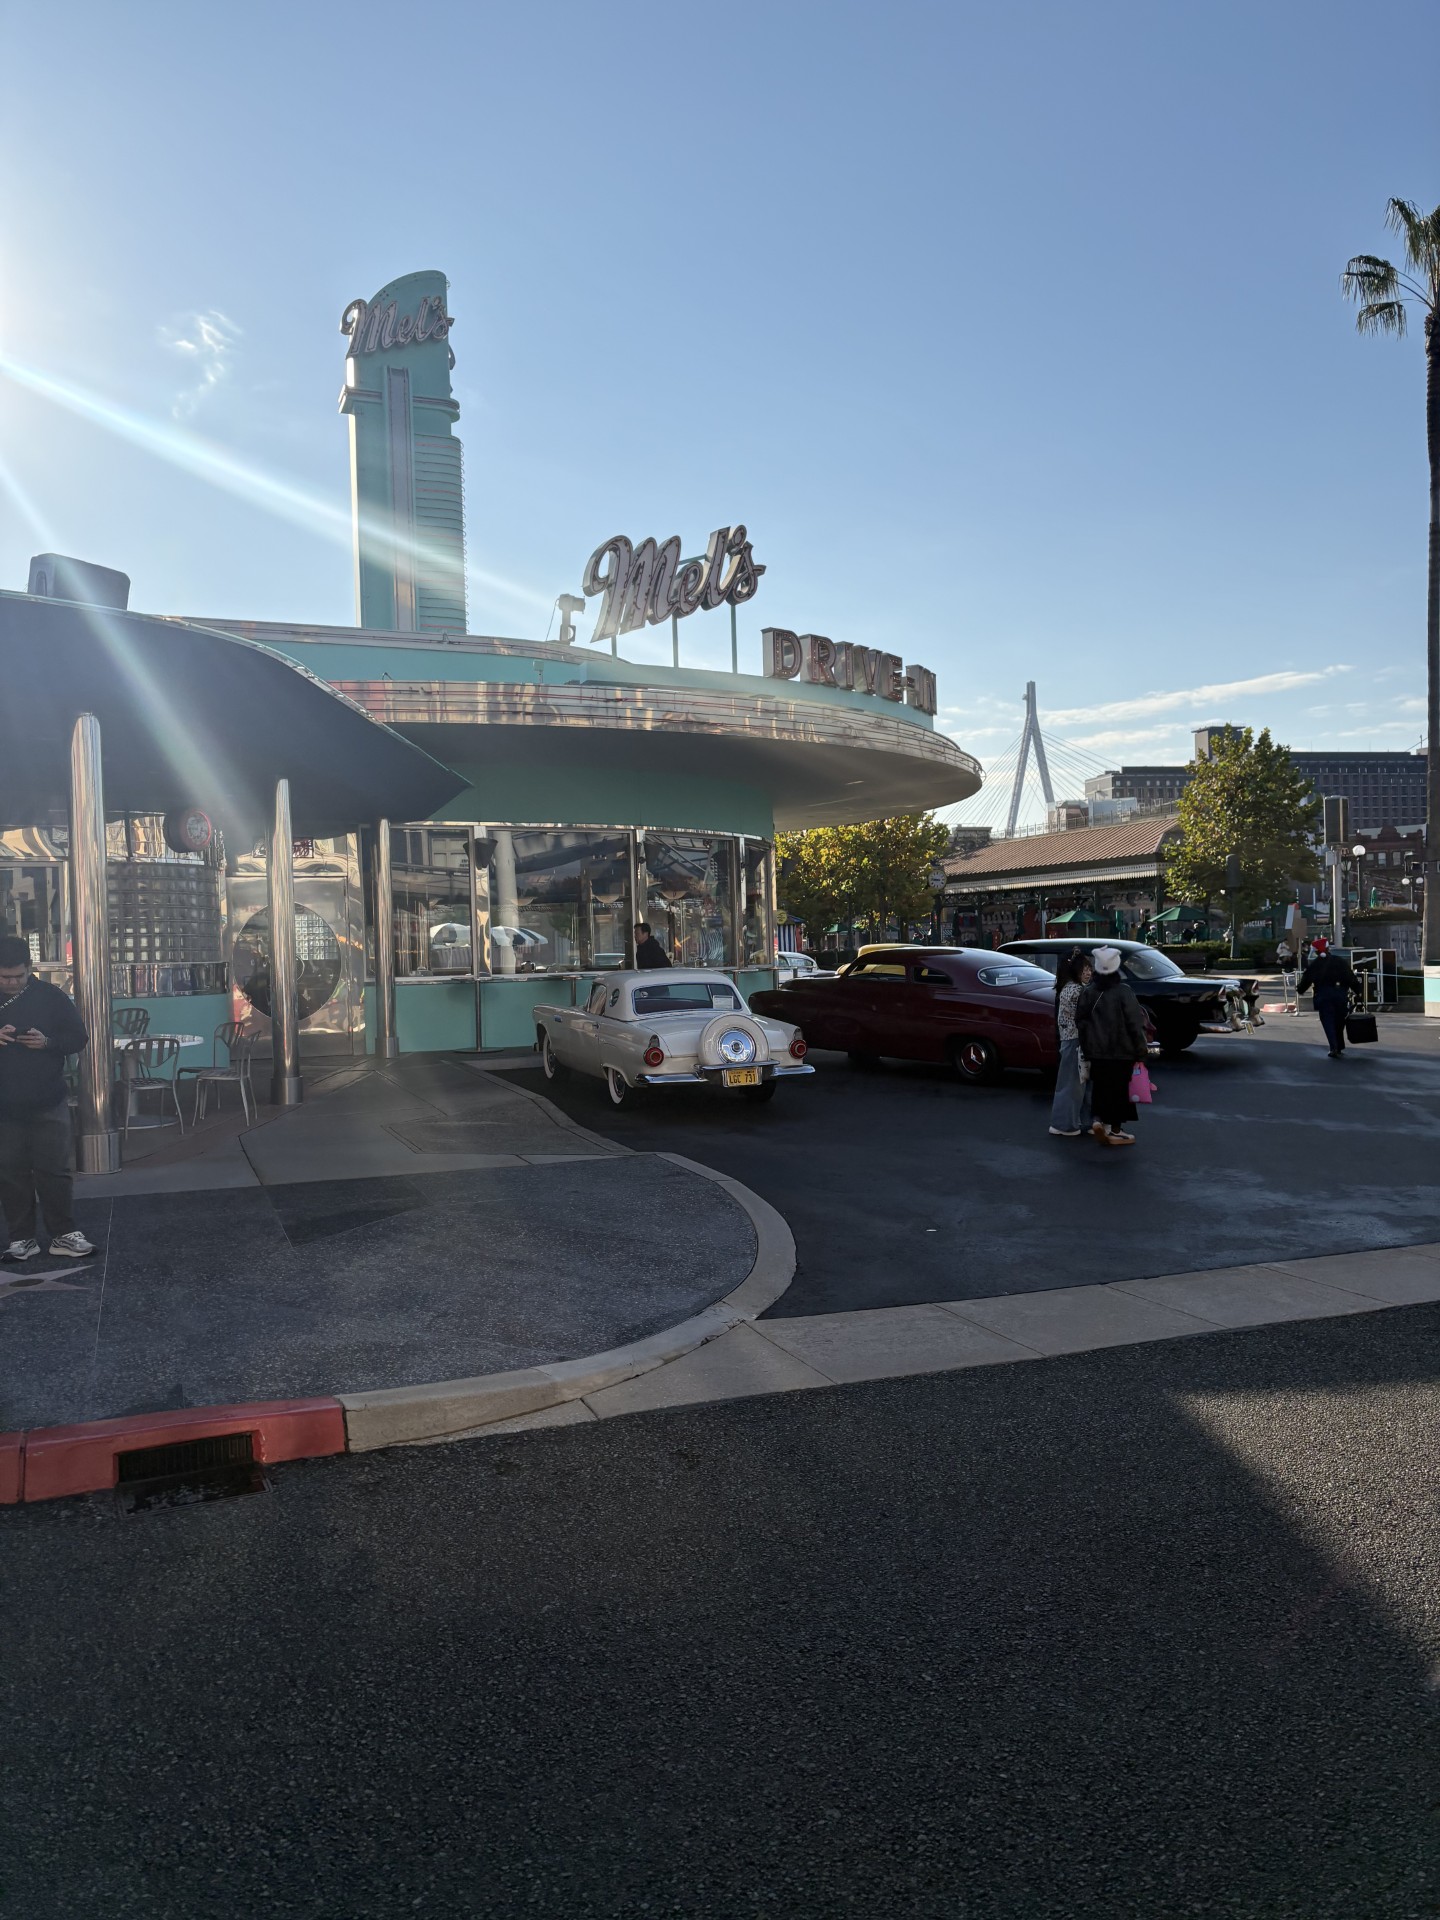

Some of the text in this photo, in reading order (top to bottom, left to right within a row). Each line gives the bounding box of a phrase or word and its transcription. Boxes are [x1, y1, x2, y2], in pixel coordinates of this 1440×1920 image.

[341, 296, 455, 355] Mel's
[582, 524, 766, 642] Mel's
[761, 627, 937, 714] DRIVE-IN
[744, 1073, 756, 1083] 731
